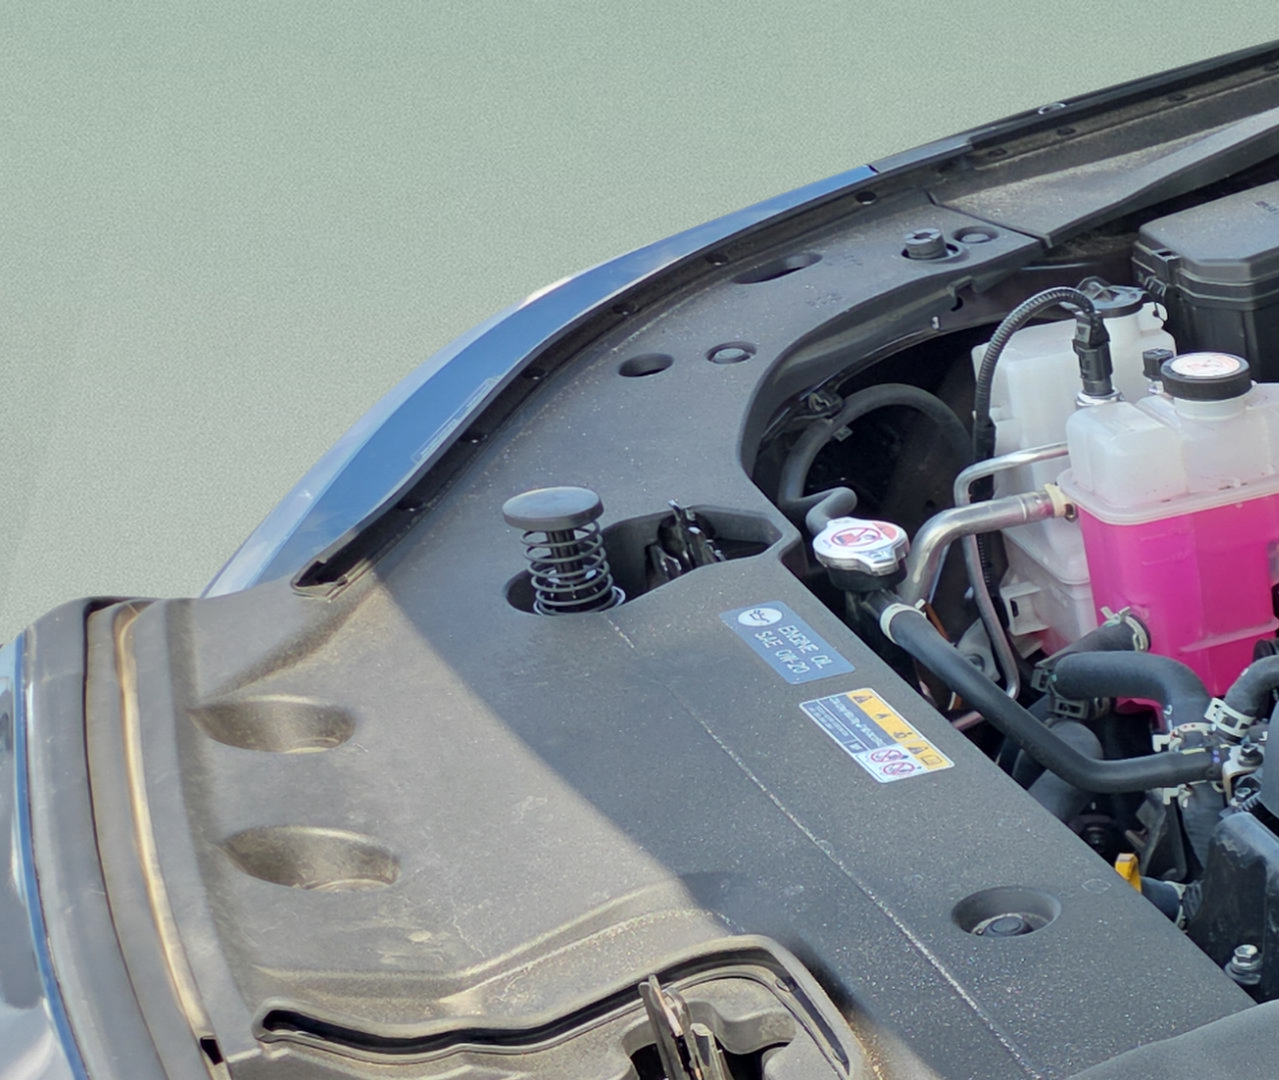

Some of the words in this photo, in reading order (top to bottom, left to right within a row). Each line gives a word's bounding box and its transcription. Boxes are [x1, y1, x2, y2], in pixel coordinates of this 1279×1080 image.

[753, 630, 784, 649] SAE
[774, 647, 811, 676] 0W-20
[776, 624, 820, 656] ENGINE
[810, 653, 834, 669] OIL
